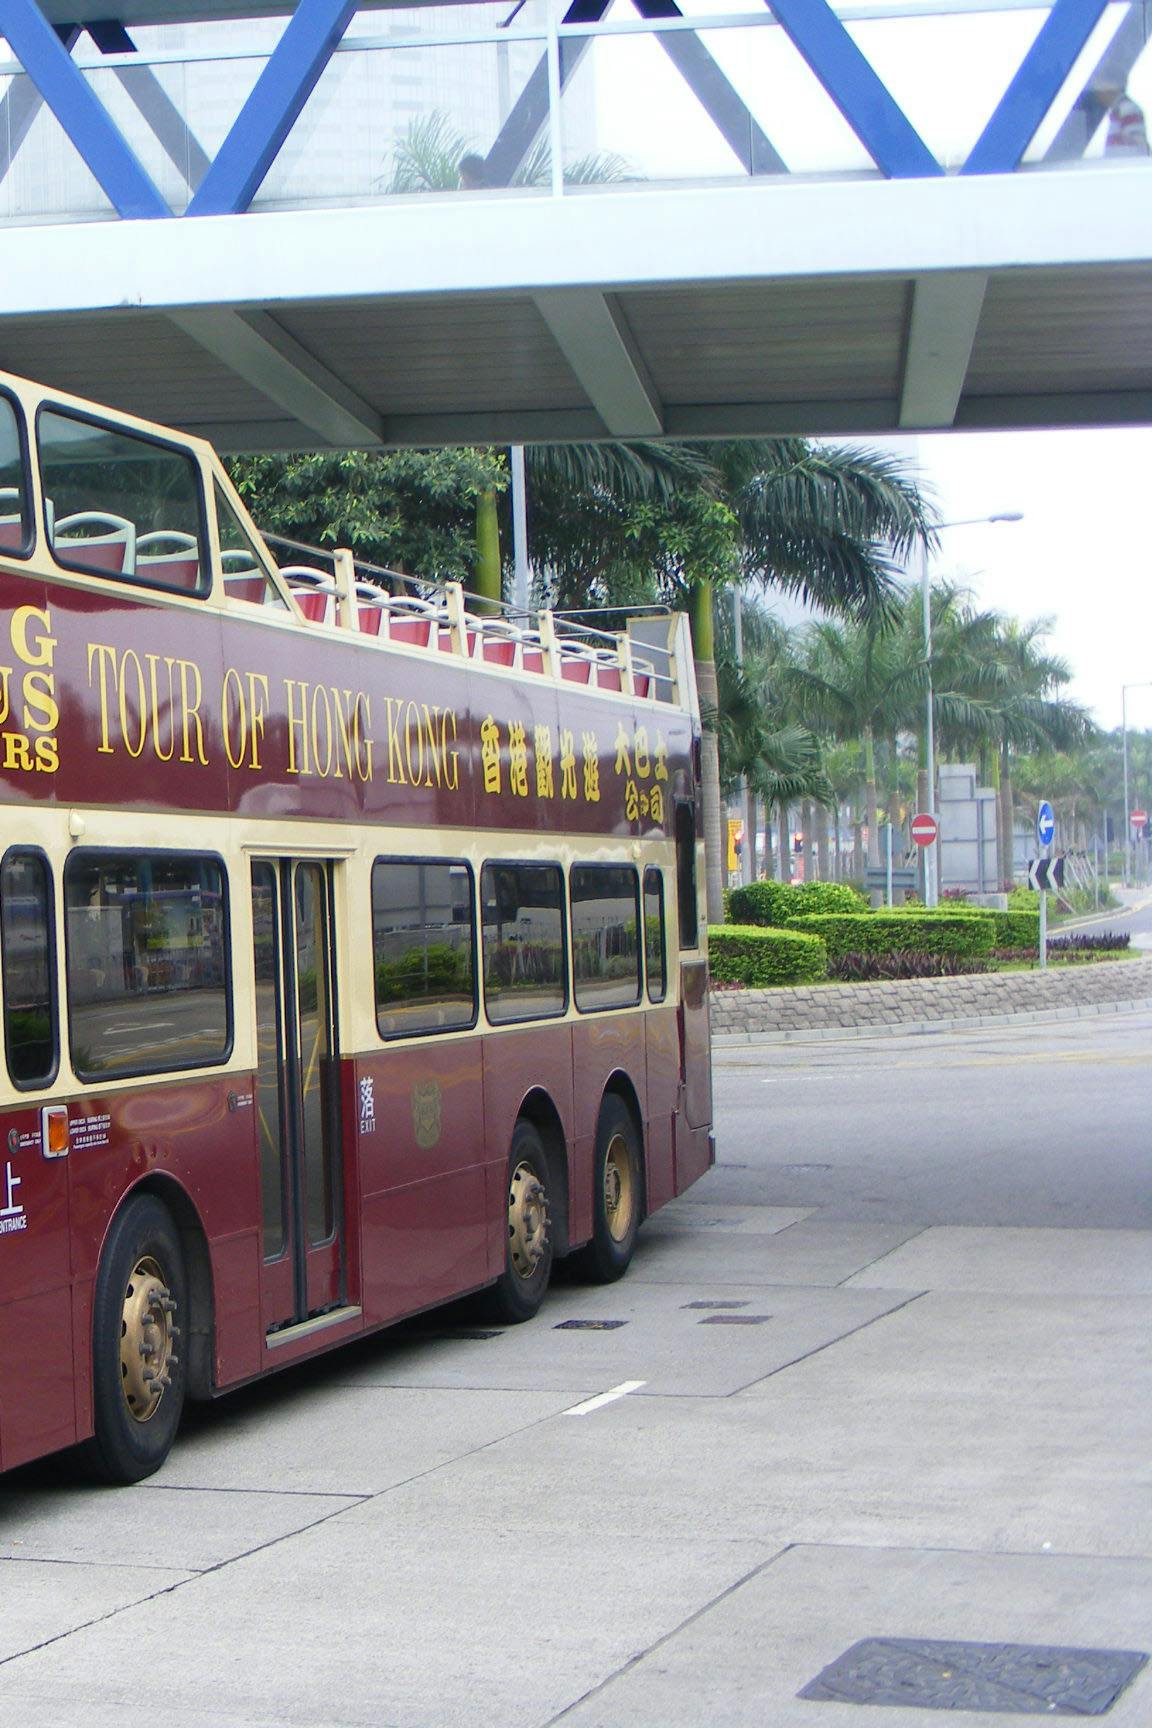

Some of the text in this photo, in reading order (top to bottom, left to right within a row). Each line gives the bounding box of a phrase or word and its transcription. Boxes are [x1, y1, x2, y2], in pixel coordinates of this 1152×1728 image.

[87, 643, 460, 790] TOUR OF HONG KONG
[359, 1076, 375, 1119] 落
[360, 1118, 377, 1135] EXIT
[0, 1161, 24, 1217] 上
